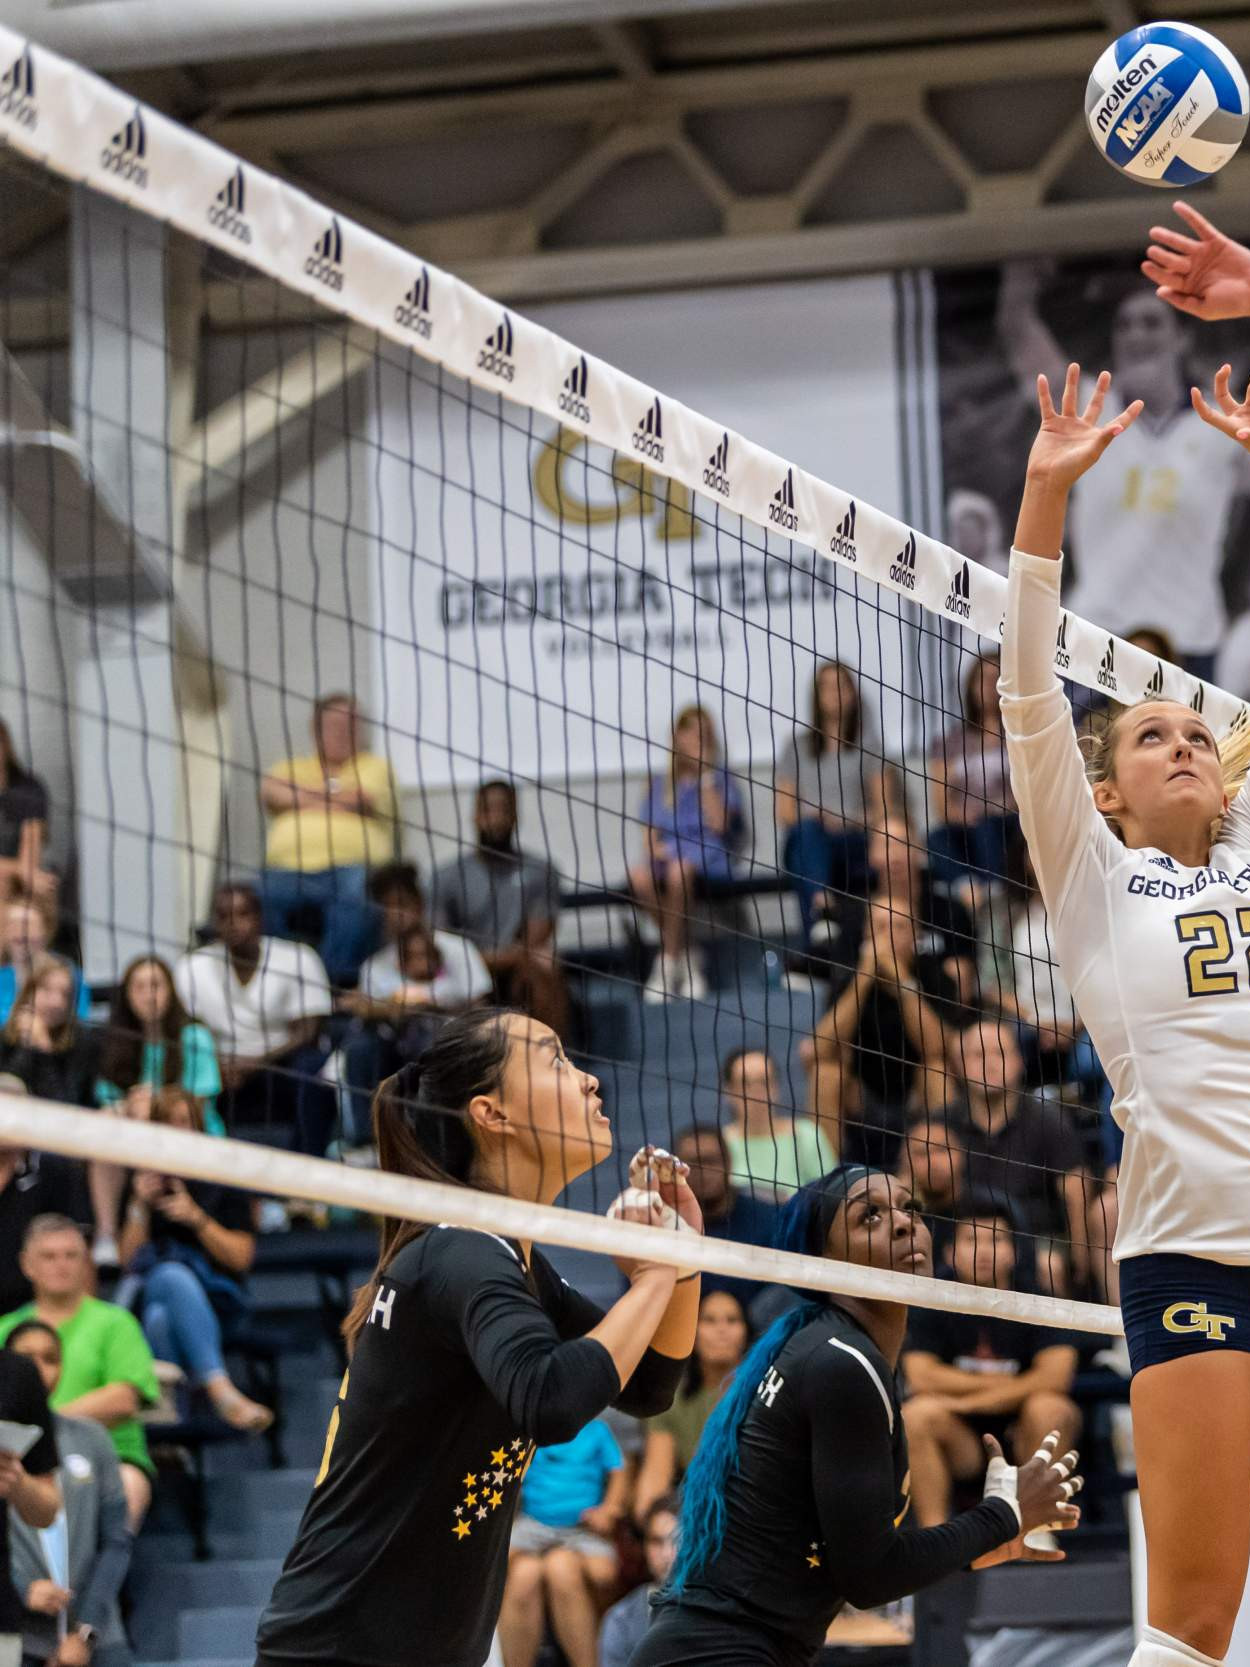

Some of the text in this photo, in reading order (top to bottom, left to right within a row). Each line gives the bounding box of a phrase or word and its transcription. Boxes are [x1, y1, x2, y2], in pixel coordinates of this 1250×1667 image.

[1097, 57, 1157, 133] molten
[1115, 81, 1175, 151] NCAA
[1144, 141, 1171, 168] Super
[1170, 97, 1199, 138] Touch
[558, 392, 590, 424] adidas
[632, 432, 665, 463] adidas
[703, 468, 730, 497] adidas
[768, 503, 798, 532] adidas
[830, 535, 857, 562] adidas
[889, 562, 916, 591] adidas
[440, 567, 667, 630] GEORGIA
[945, 594, 971, 620] adidas
[1127, 867, 1235, 901] GEORGIA
[1162, 1301, 1236, 1341] GT
